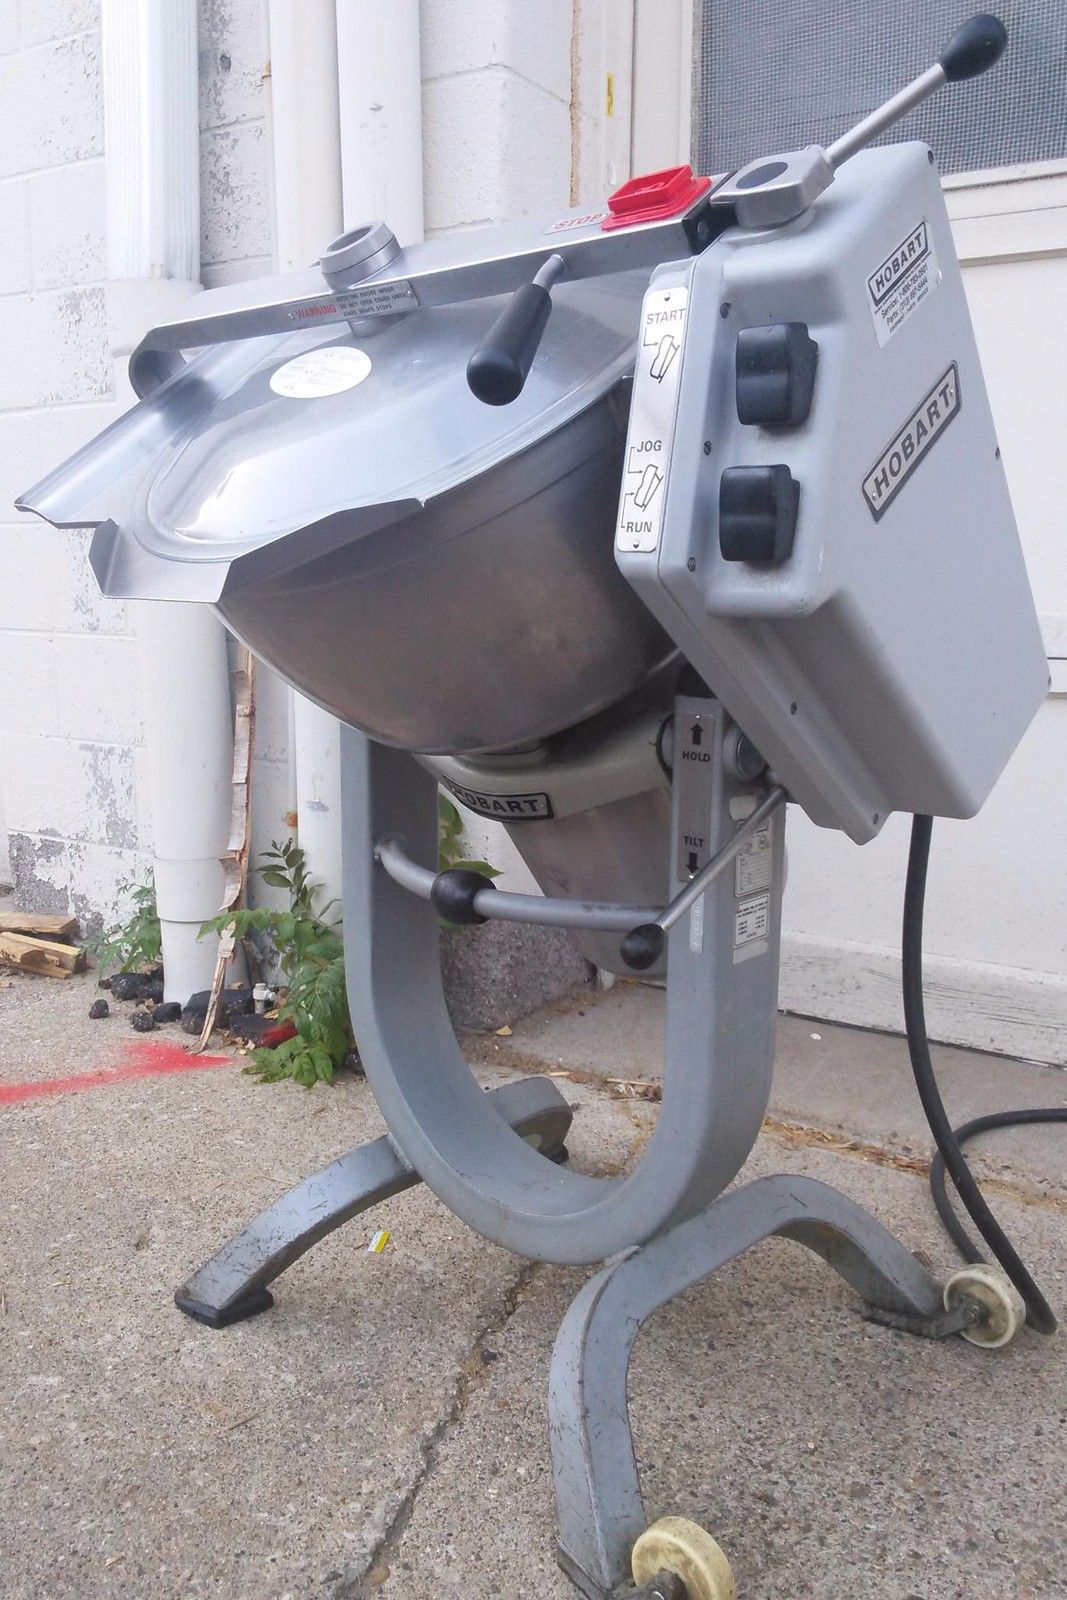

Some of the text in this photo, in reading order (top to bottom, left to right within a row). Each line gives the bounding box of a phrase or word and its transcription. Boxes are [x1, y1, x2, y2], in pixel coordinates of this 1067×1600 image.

[556, 213, 602, 229] STOP
[875, 232, 922, 293] HOBART
[297, 304, 337, 318] WARNING
[646, 308, 686, 325] START
[636, 440, 662, 452] JOG
[873, 383, 950, 498] HOBART
[626, 521, 652, 533] RUN
[682, 751, 711, 762] HOLD
[452, 785, 538, 812] HOBART
[683, 835, 704, 848] TILT
